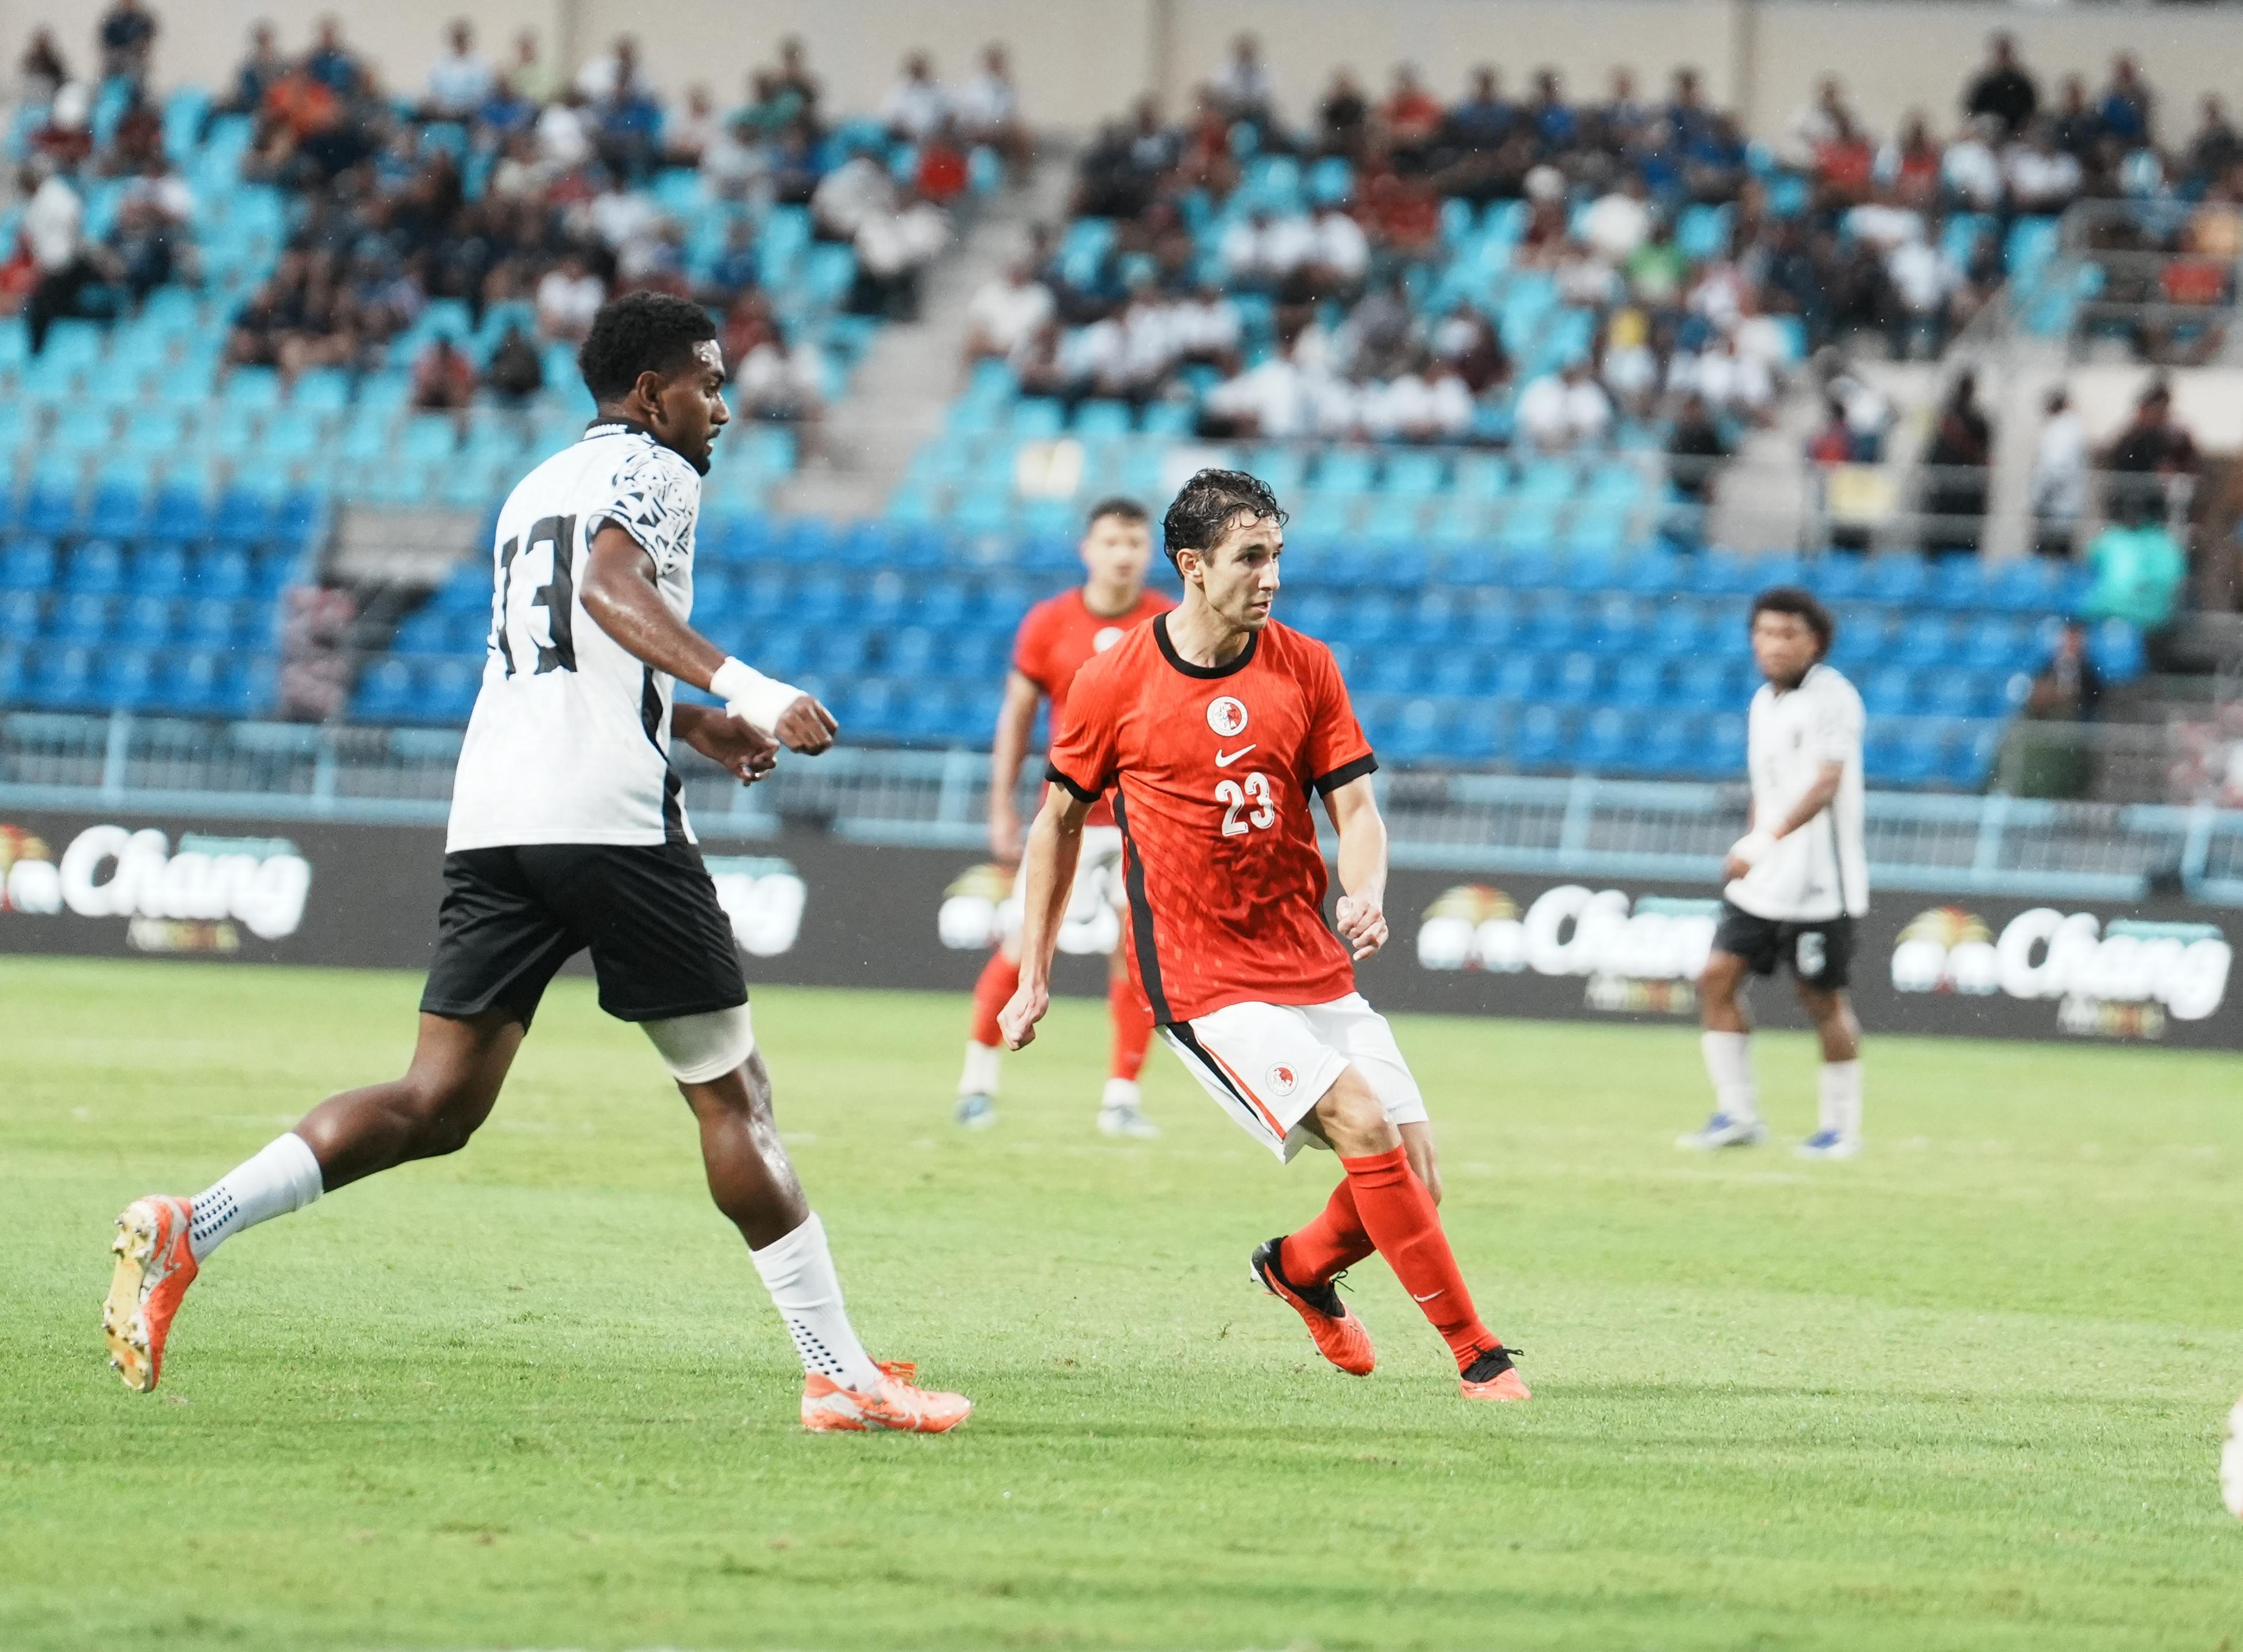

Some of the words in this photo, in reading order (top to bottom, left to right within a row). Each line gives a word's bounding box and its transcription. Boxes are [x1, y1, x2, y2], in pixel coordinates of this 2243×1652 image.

[1215, 771, 1275, 836] 23
[60, 825, 311, 940] Chang
[1996, 907, 2233, 1020] Chang
